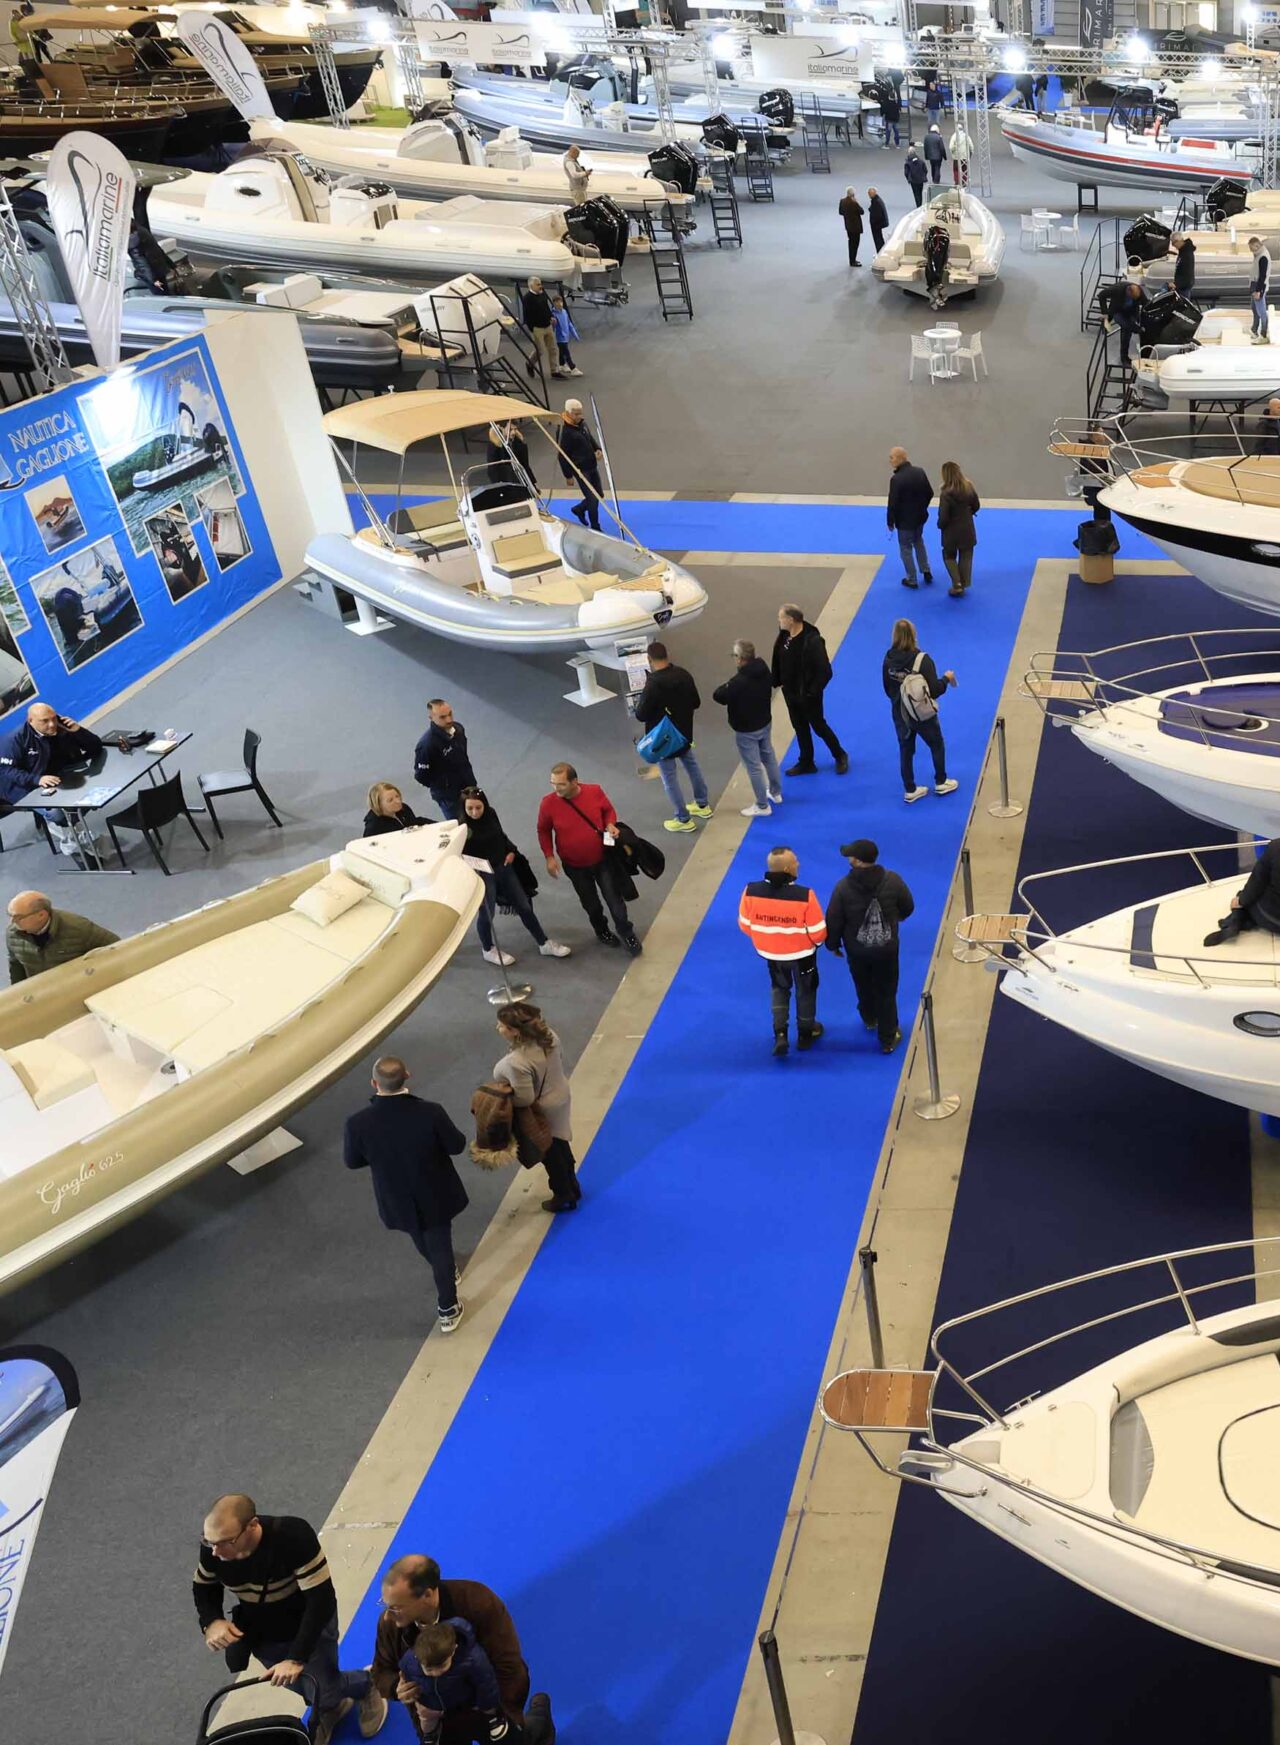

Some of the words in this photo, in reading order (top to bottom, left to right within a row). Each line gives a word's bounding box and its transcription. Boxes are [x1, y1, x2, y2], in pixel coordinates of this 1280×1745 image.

[93, 172, 118, 280] Italiamarine
[8, 410, 76, 453] NAUTICA
[16, 432, 90, 478] GAGLIONE
